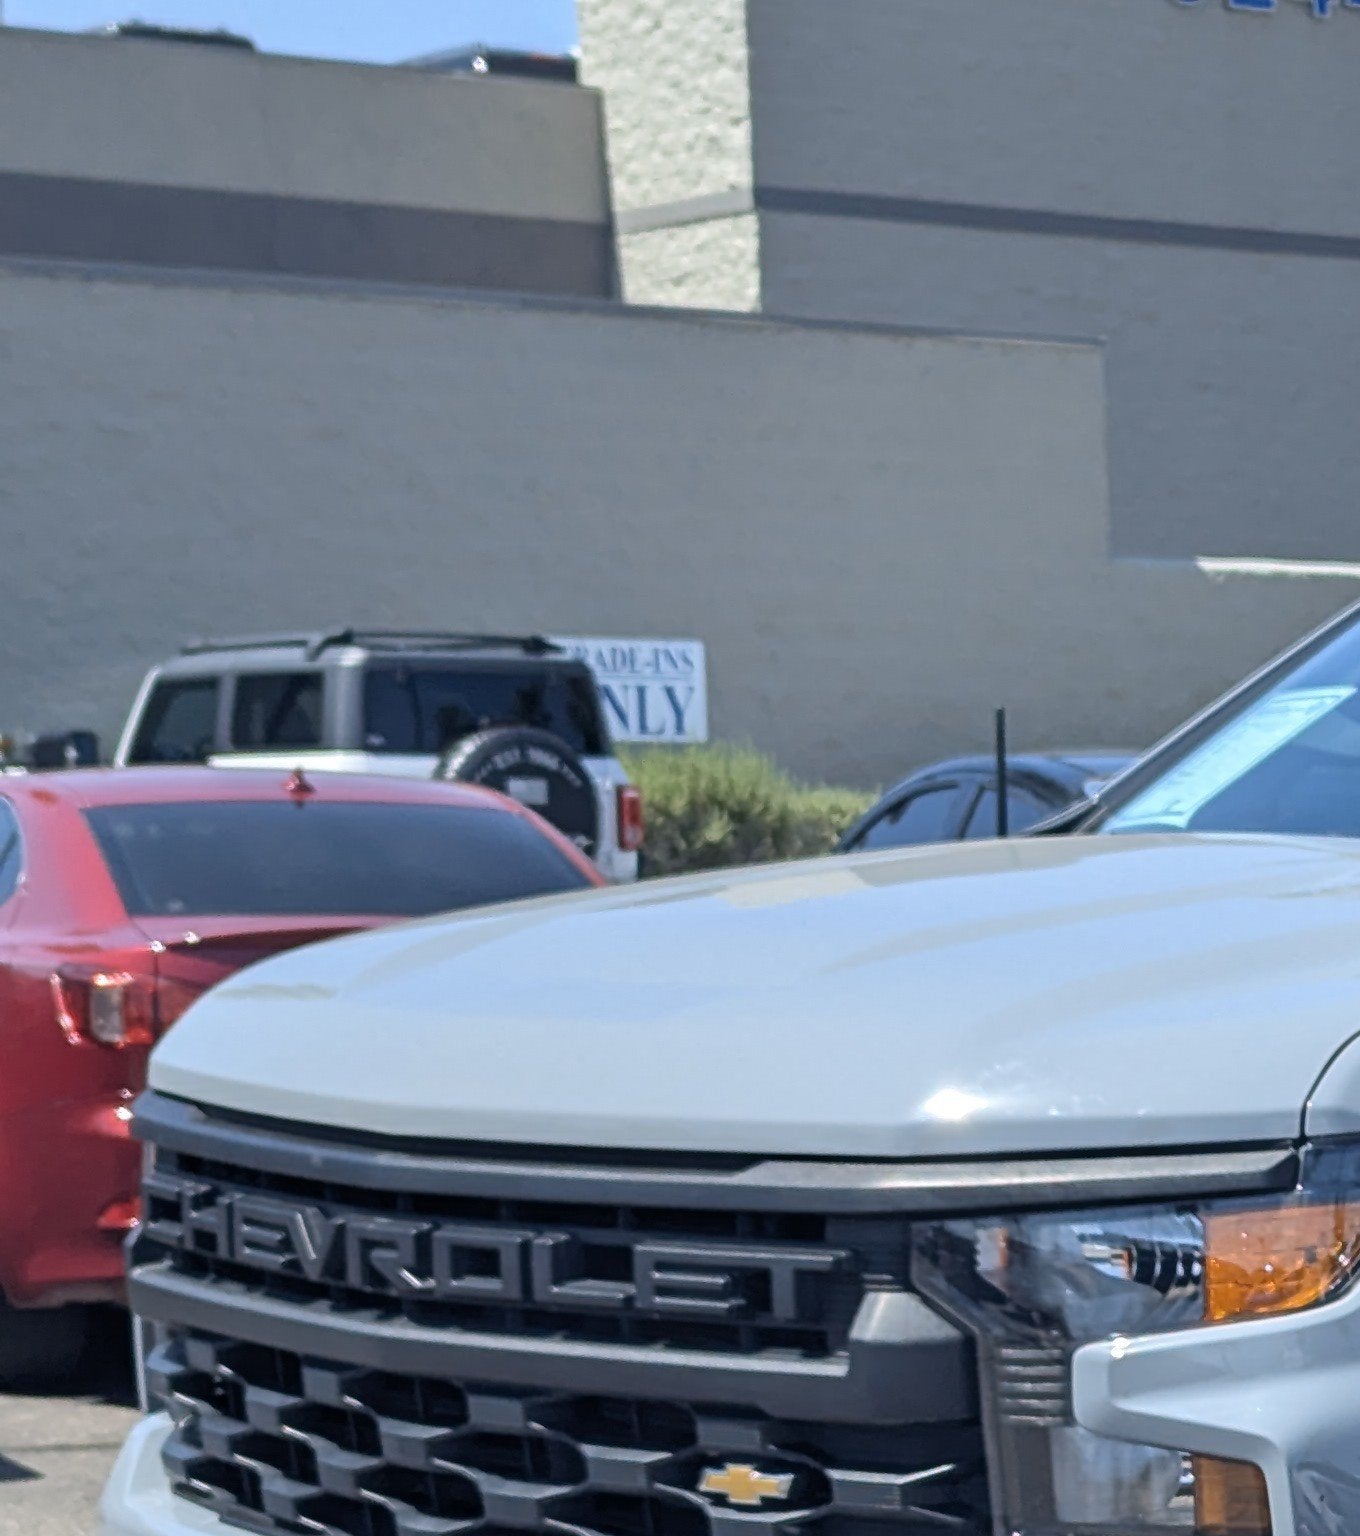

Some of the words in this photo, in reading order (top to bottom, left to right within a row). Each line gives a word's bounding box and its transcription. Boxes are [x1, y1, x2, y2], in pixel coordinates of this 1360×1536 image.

[573, 645, 697, 674] RADE-INS
[597, 684, 697, 736] NLY
[142, 1174, 847, 1321] CHEVROLET
